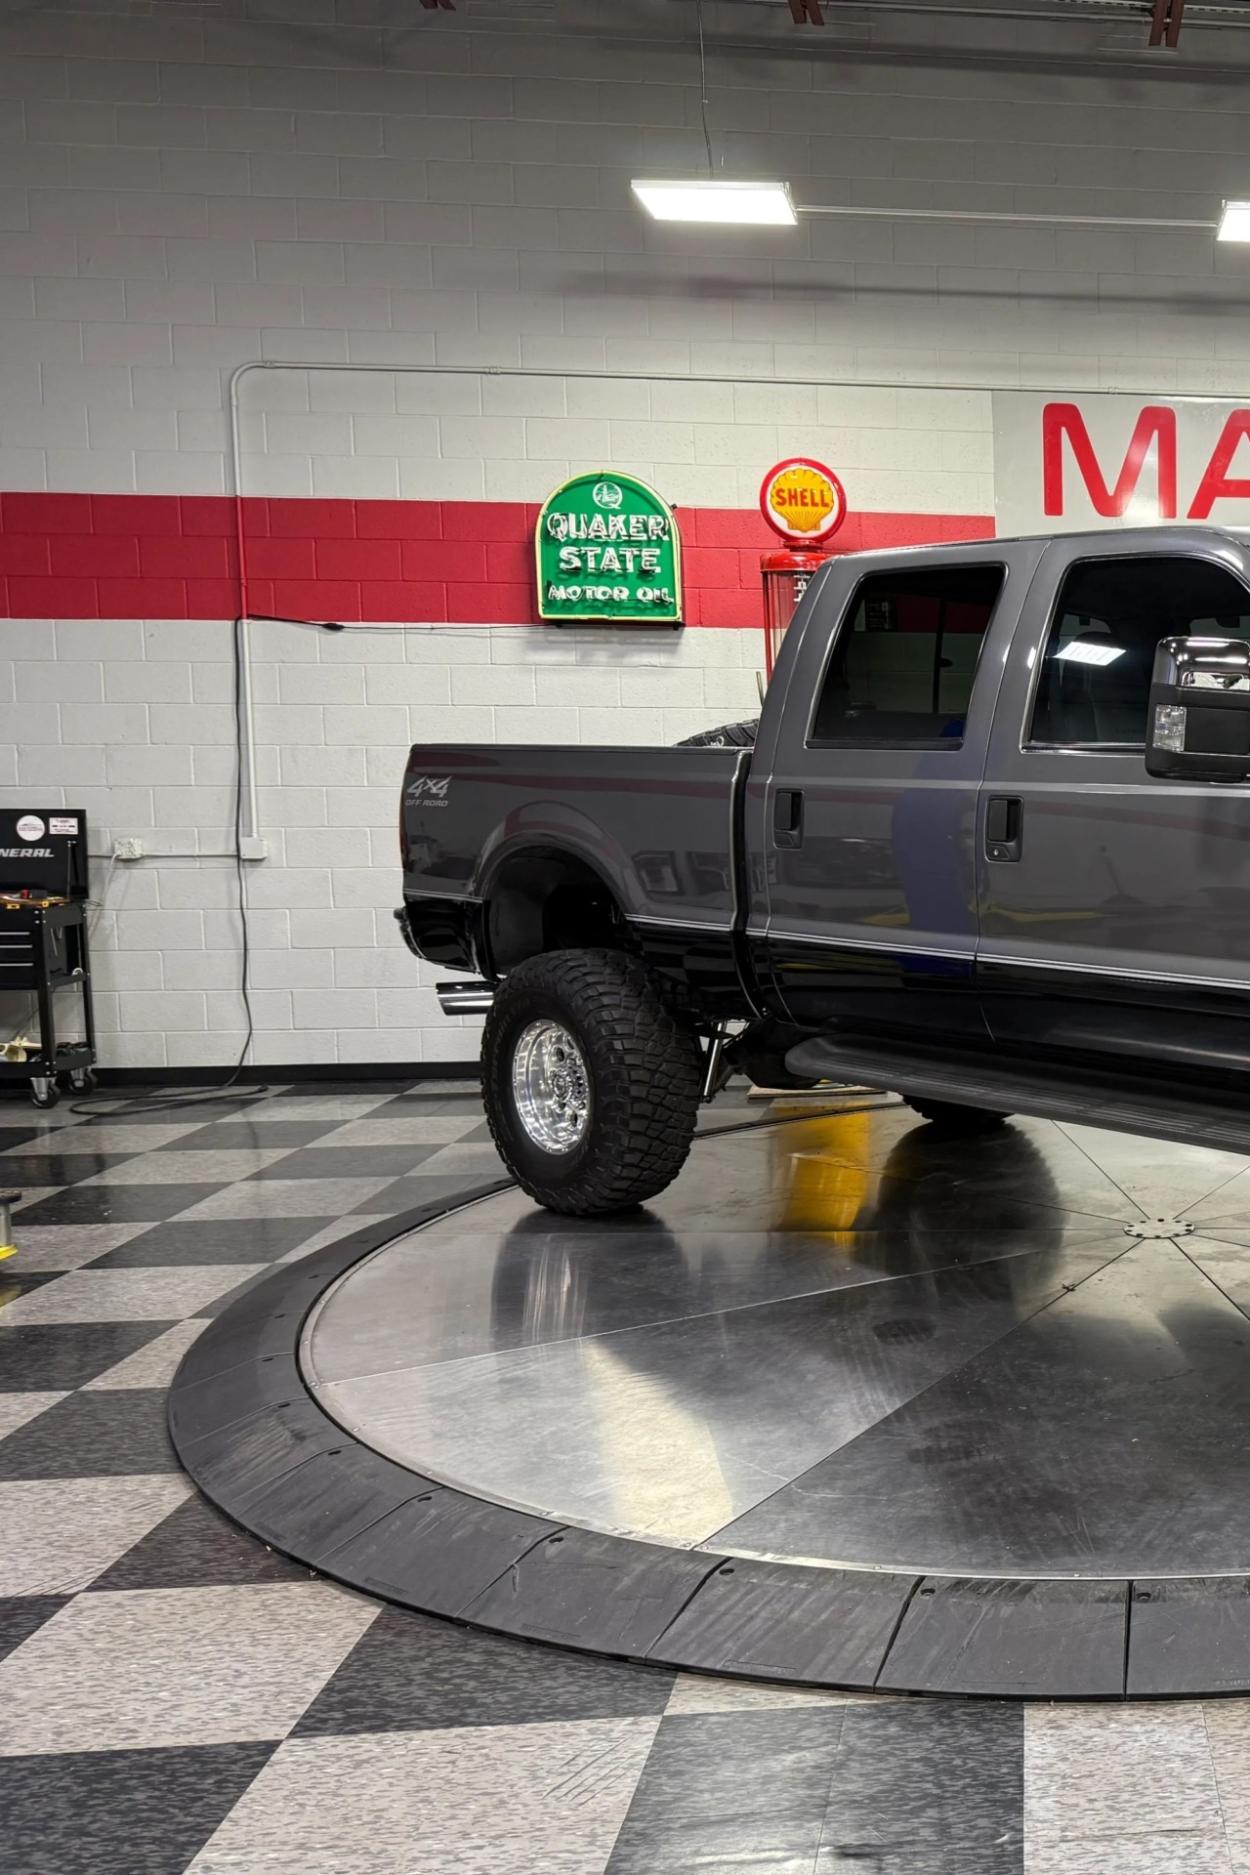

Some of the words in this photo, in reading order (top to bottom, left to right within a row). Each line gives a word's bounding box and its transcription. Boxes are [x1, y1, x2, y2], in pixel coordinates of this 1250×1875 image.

[774, 488, 830, 509] SHELL
[547, 512, 670, 542] QUAKER
[559, 545, 661, 573] STATE
[548, 585, 630, 601] MOTOR
[636, 586, 674, 604] OIL
